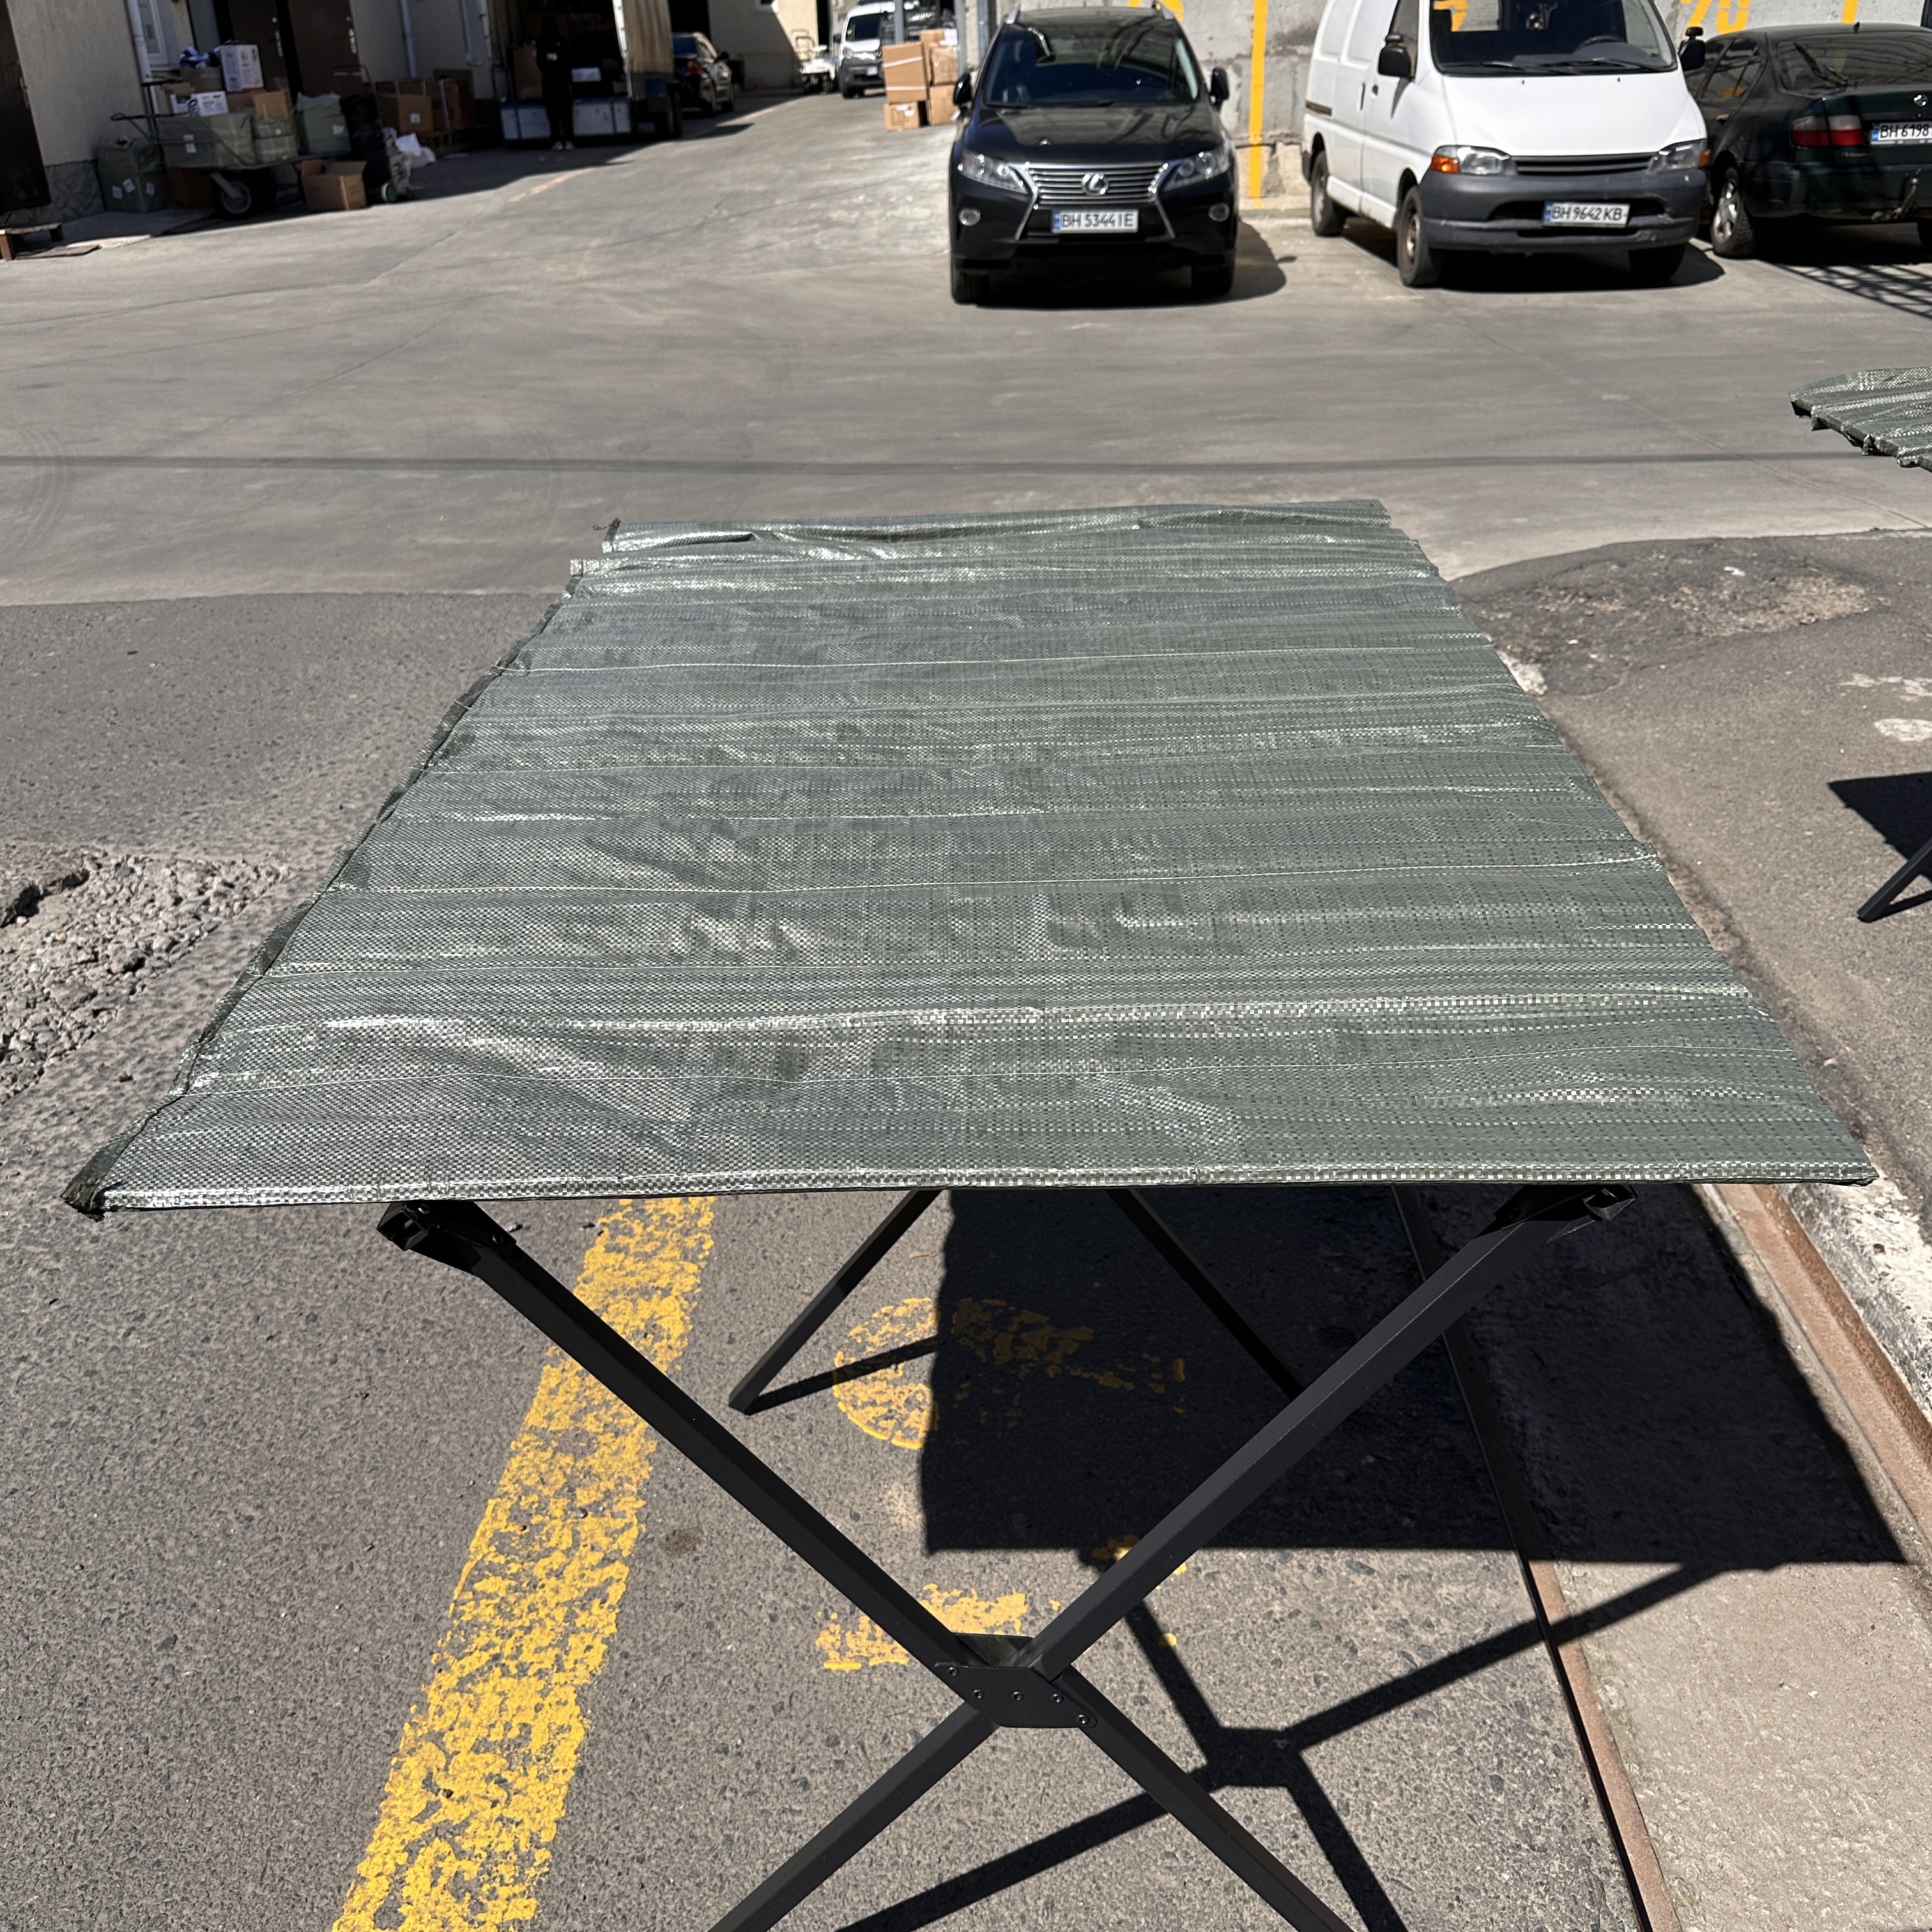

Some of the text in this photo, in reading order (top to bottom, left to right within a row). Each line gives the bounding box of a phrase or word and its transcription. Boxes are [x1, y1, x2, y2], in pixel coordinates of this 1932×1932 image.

[1880, 123, 1929, 138] BH 6198
[1062, 213, 1082, 227] BH
[1084, 213, 1116, 227] 5344
[1551, 205, 1572, 220] BH
